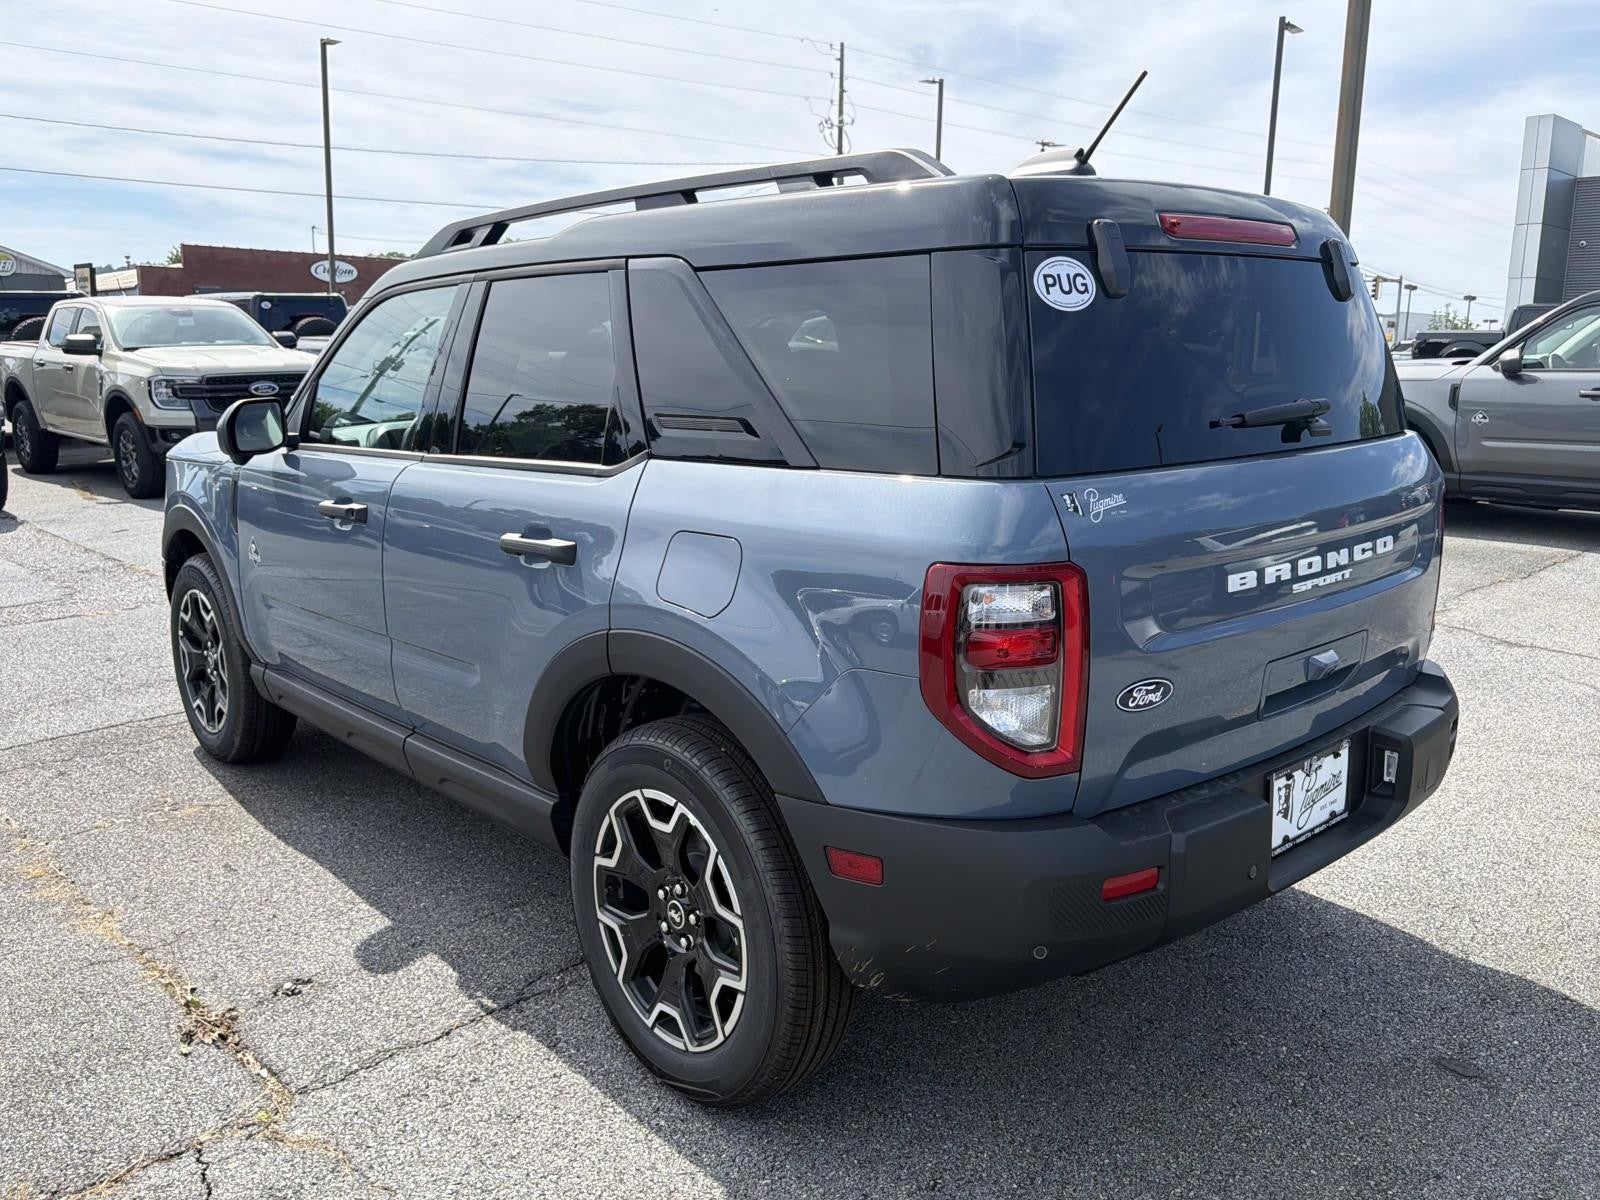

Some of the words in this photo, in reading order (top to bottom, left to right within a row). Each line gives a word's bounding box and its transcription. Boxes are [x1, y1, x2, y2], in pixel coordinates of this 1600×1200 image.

[1042, 272, 1090, 296] PUG
[1084, 488, 1127, 523] Pugmire
[1227, 535, 1394, 593] BRONCO
[1292, 568, 1353, 594] SPORT
[1128, 684, 1164, 707] Ford
